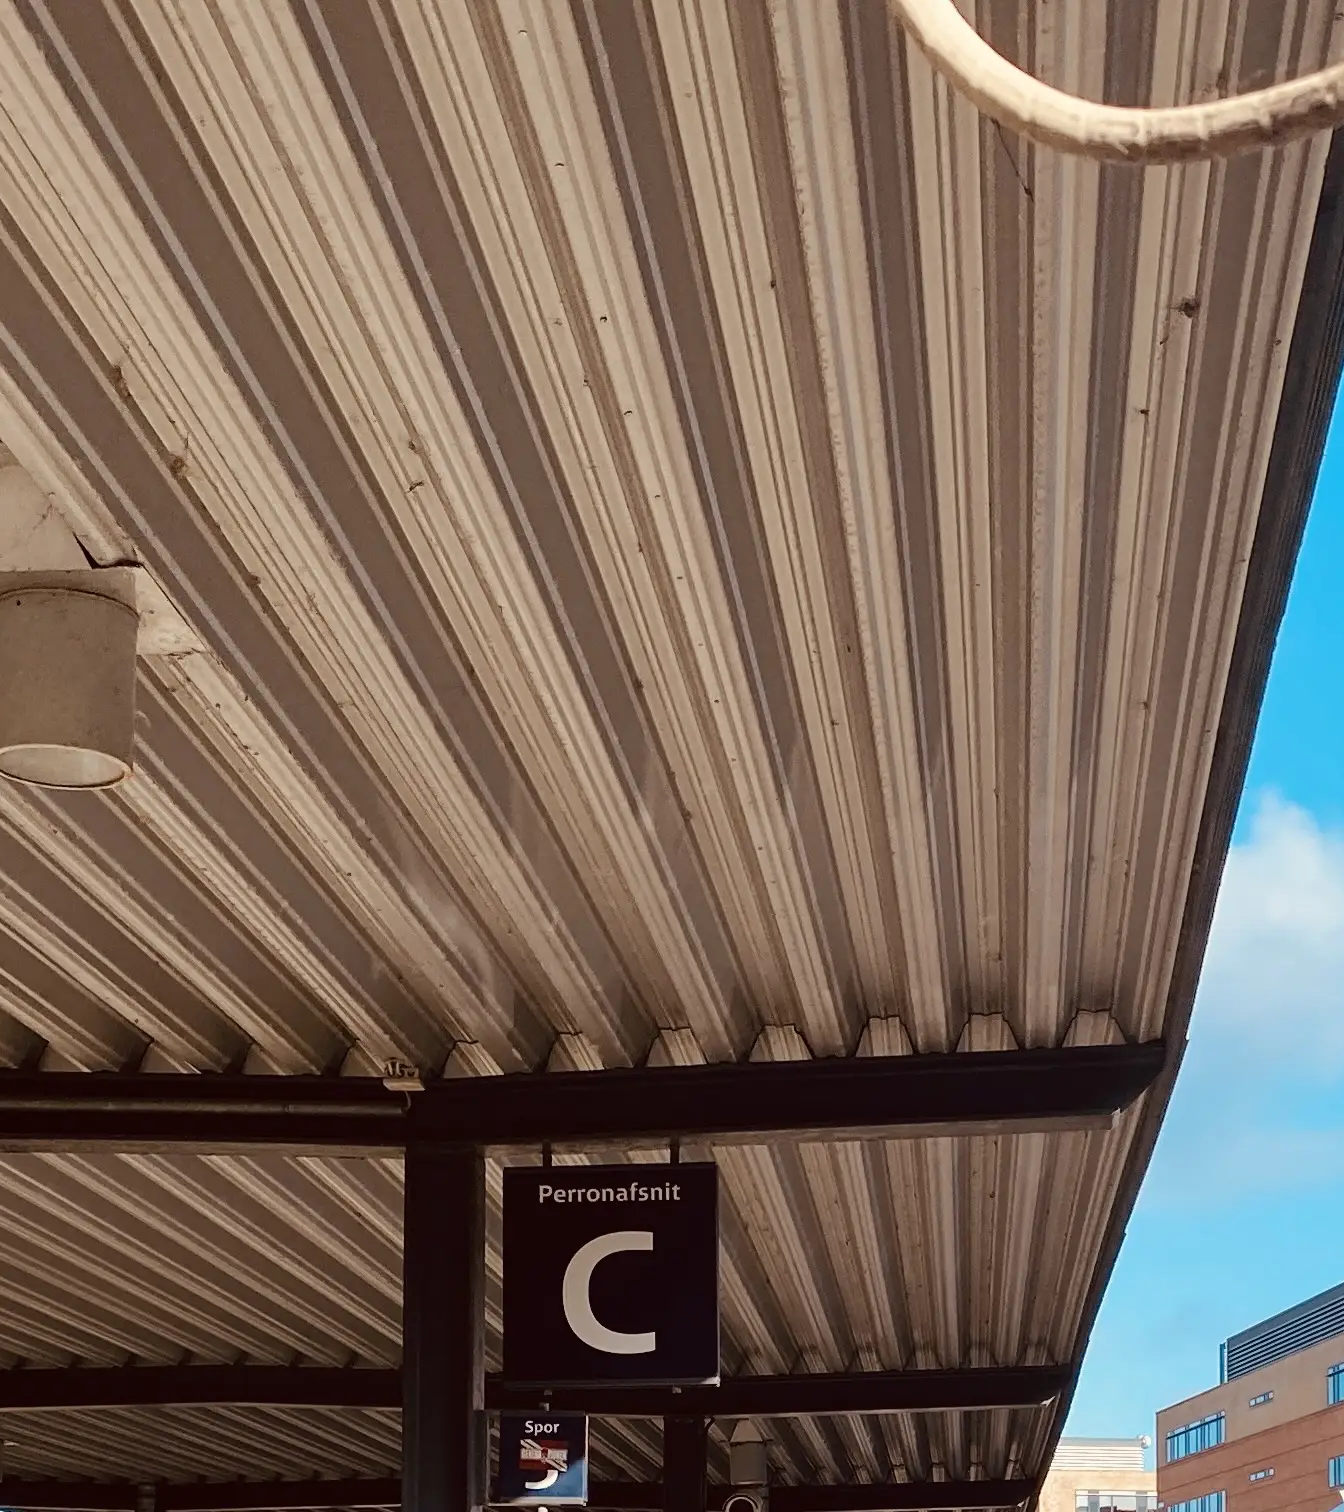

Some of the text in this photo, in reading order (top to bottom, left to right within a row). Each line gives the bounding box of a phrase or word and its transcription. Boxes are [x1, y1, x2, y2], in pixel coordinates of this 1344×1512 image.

[538, 1182, 681, 1204] Perronafsnit
[562, 1231, 656, 1354] C
[525, 1420, 560, 1436] Spor
